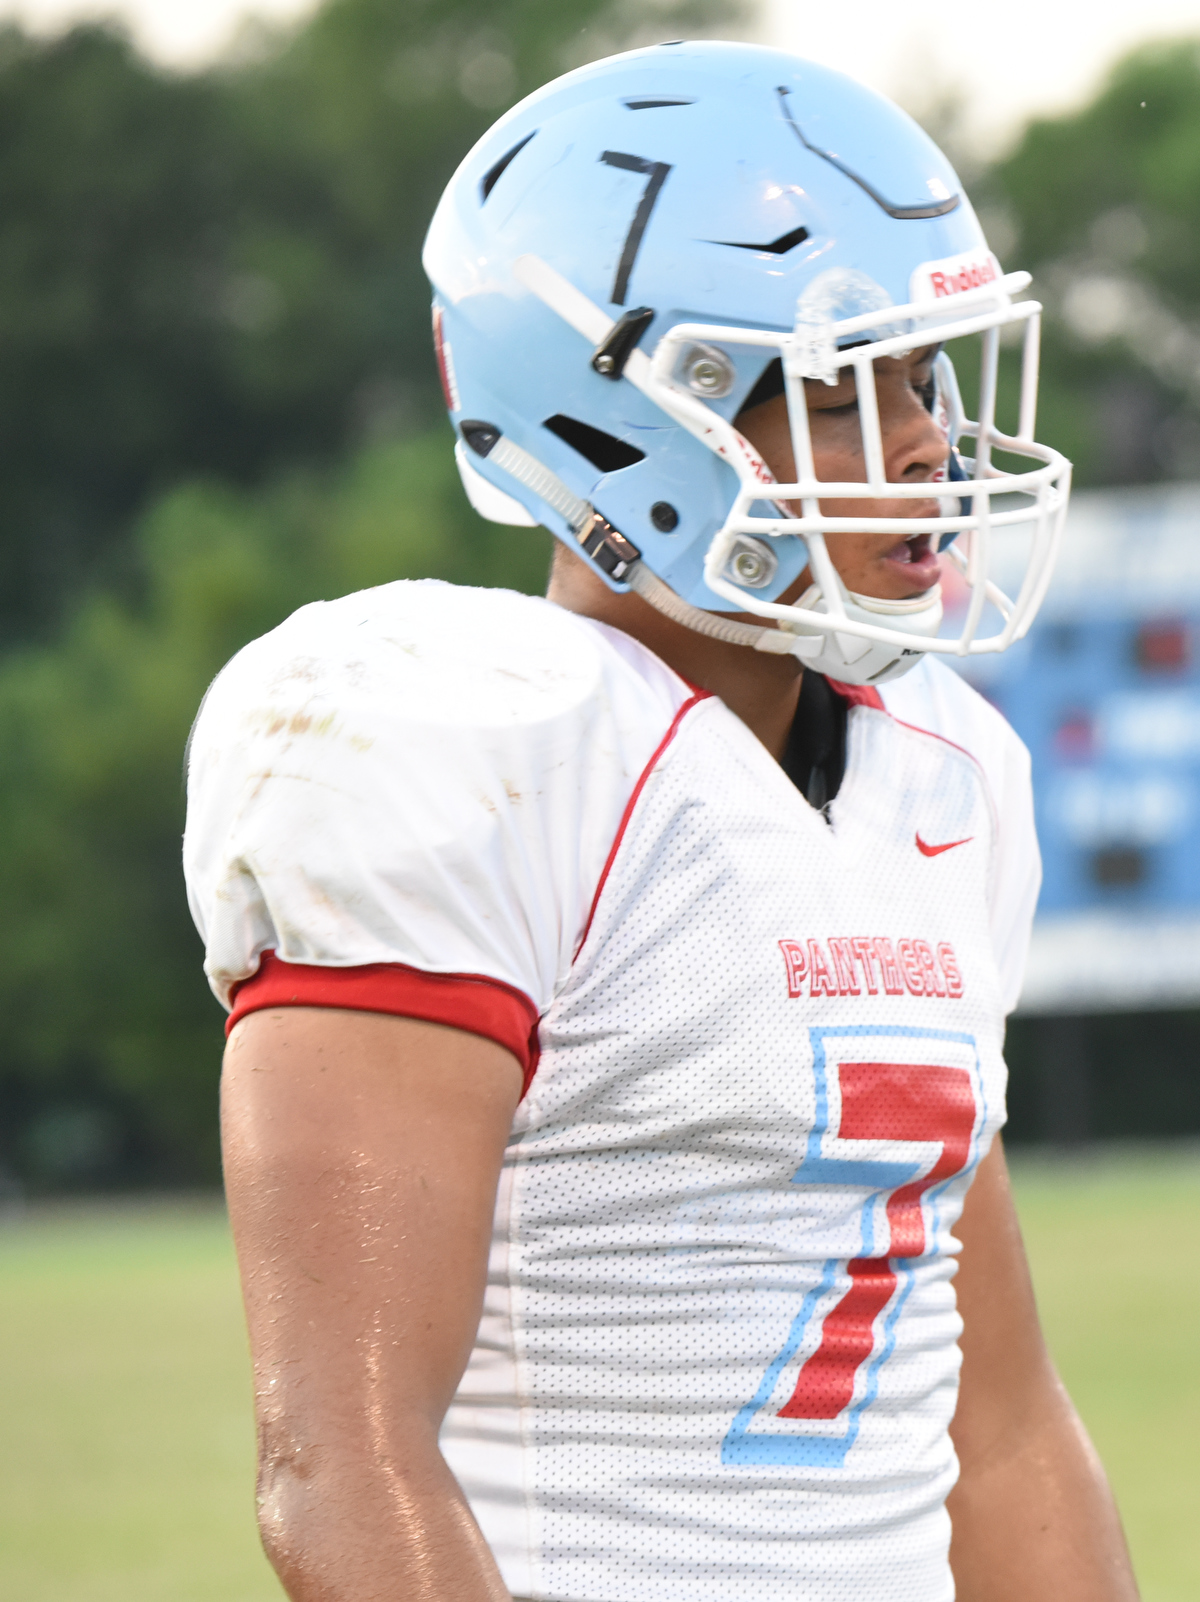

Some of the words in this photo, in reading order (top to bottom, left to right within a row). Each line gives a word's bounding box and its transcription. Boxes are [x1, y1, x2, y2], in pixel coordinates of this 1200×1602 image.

[598, 149, 673, 306] 7
[778, 937, 964, 998] PANTHERS
[721, 1025, 987, 1467] 7
